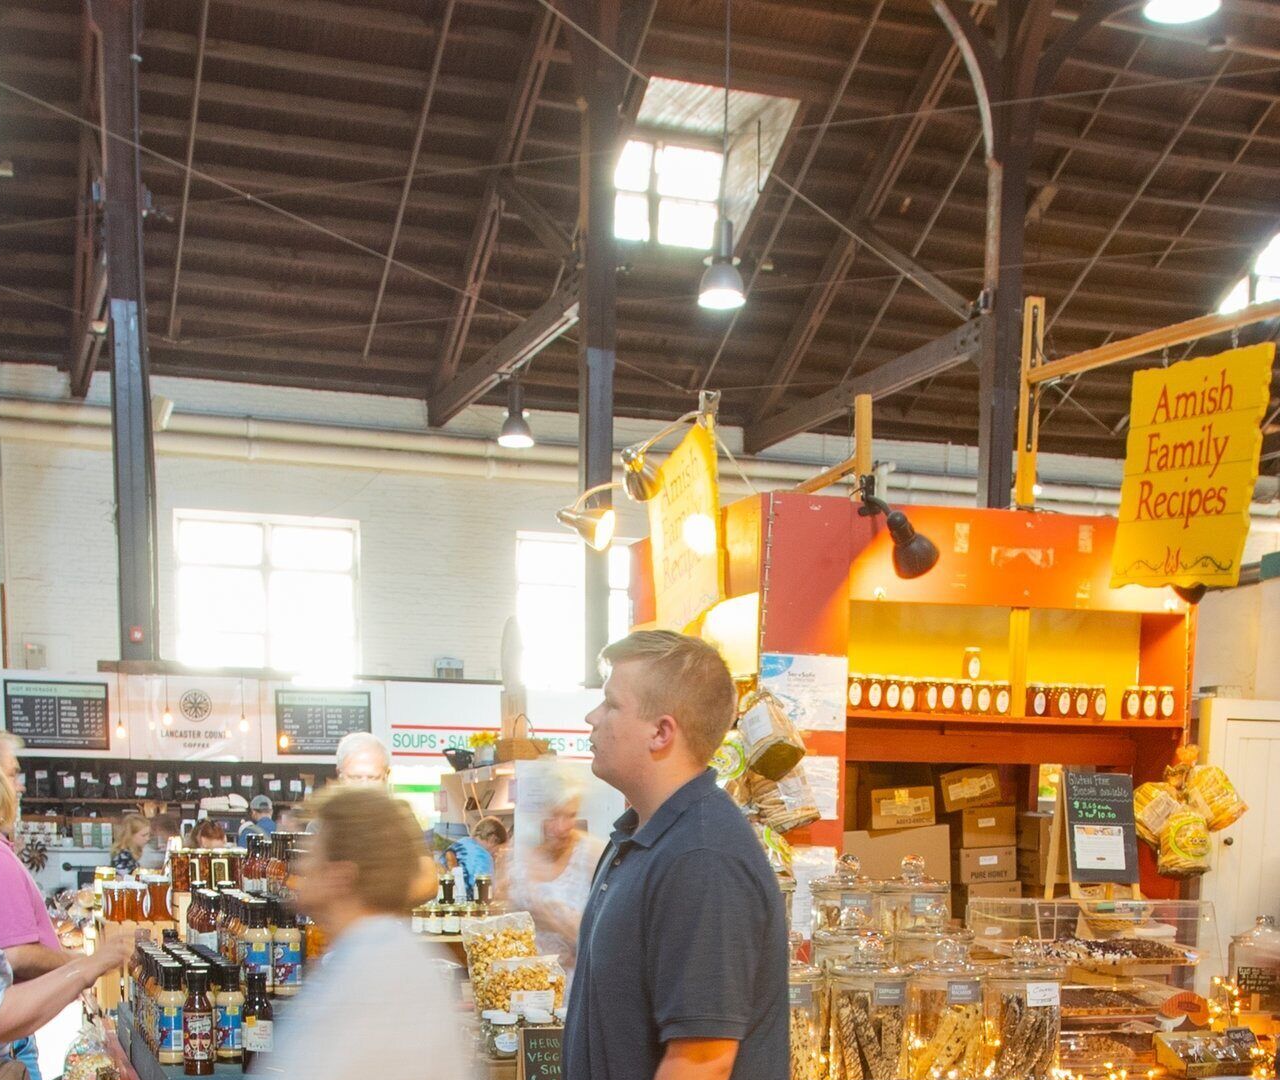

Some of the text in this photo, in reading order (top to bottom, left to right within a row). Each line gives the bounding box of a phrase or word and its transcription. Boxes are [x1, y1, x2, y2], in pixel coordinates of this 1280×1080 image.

[1151, 368, 1235, 425] Amish
[1144, 422, 1230, 479] Family
[1135, 477, 1229, 530] Recipes
[160, 729, 201, 739] LANCASTER
[392, 733, 437, 749] SOUPS
[1070, 773, 1111, 787] Gluten Free
[970, 870, 1008, 880] PURE HONEY
[527, 1052, 560, 1063] VEGG
